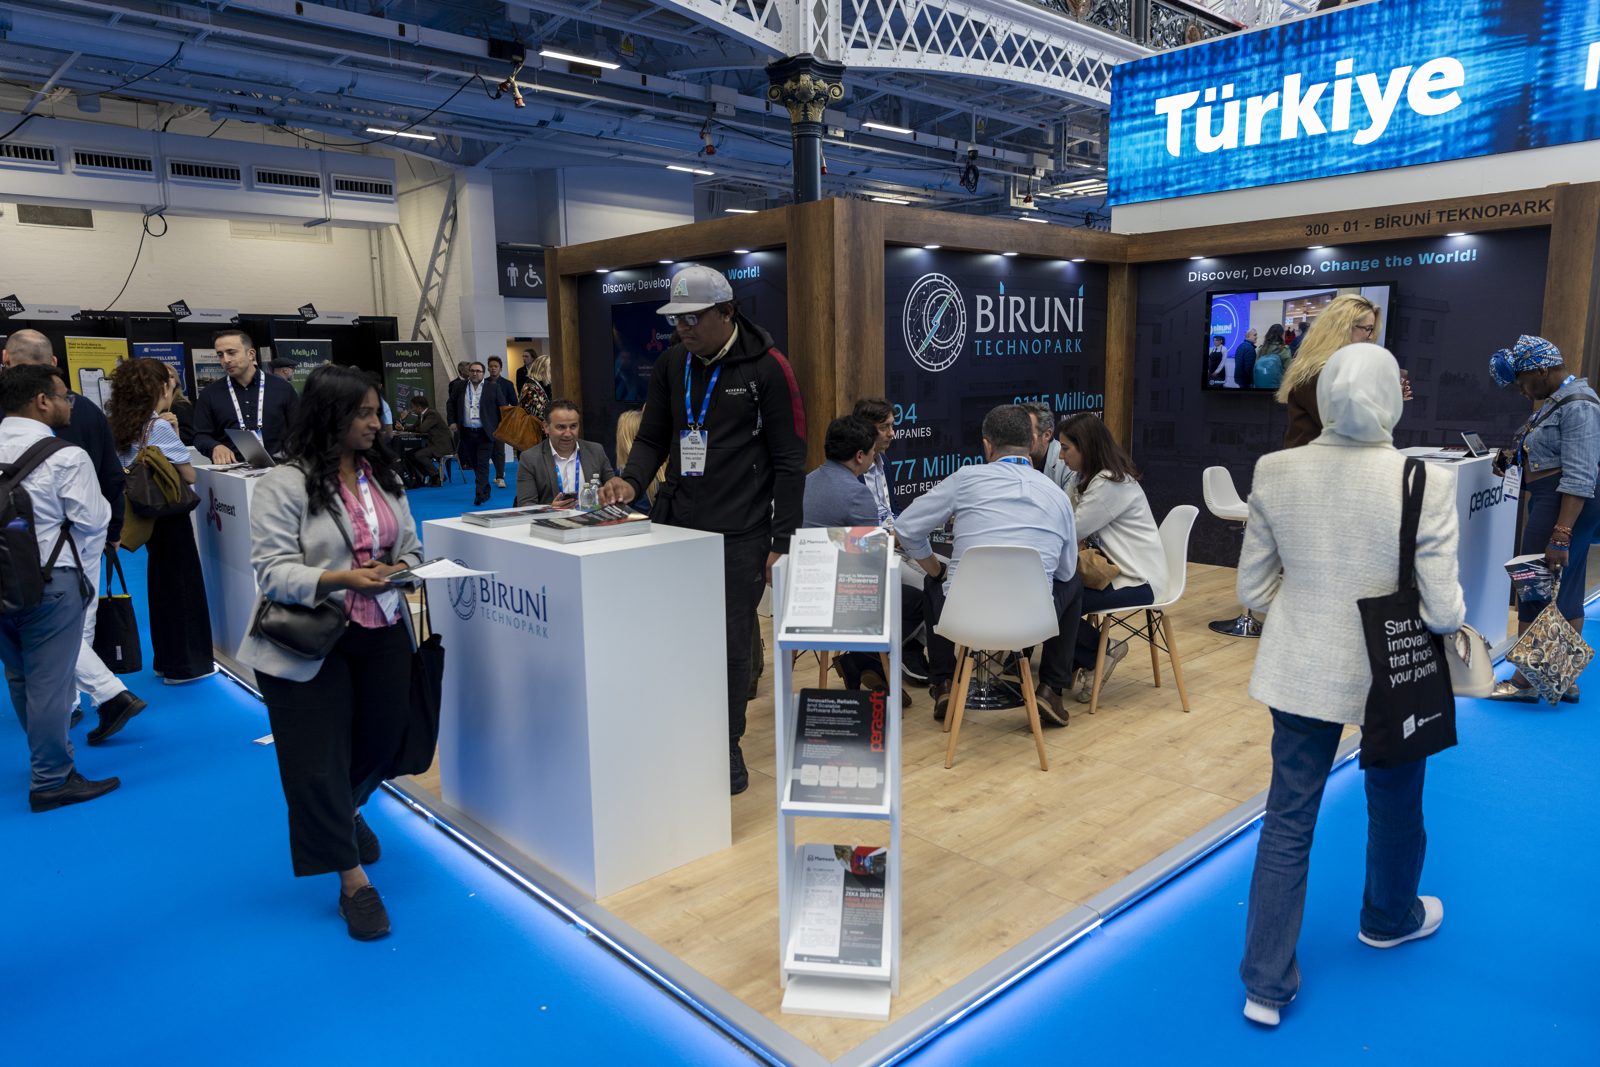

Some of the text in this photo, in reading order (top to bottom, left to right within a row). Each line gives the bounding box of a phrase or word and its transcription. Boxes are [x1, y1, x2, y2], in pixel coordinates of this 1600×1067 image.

[1154, 56, 1465, 158] Türkiye
[1305, 223, 1330, 237] 300
[1343, 220, 1359, 232] 01
[1374, 209, 1431, 230] BİRUNİ
[1436, 198, 1553, 224] TEKNOPARK
[1188, 248, 1477, 282] Discover, Develop, Change the World!
[602, 280, 637, 294] Discover,
[728, 266, 760, 281] World!
[975, 280, 1084, 333] BİRUNİ
[975, 338, 1082, 356] TECHNOPARK
[1055, 391, 1104, 412] Million
[891, 426, 932, 440] MPANIES
[214, 497, 236, 517] Gennext
[1469, 477, 1507, 520] perasof
[480, 606, 549, 640] TECHNOPARK
[1384, 618, 1413, 635] Start
[1388, 652, 1410, 669] that
[1388, 669, 1413, 689] your
[870, 690, 885, 753] perasoft
